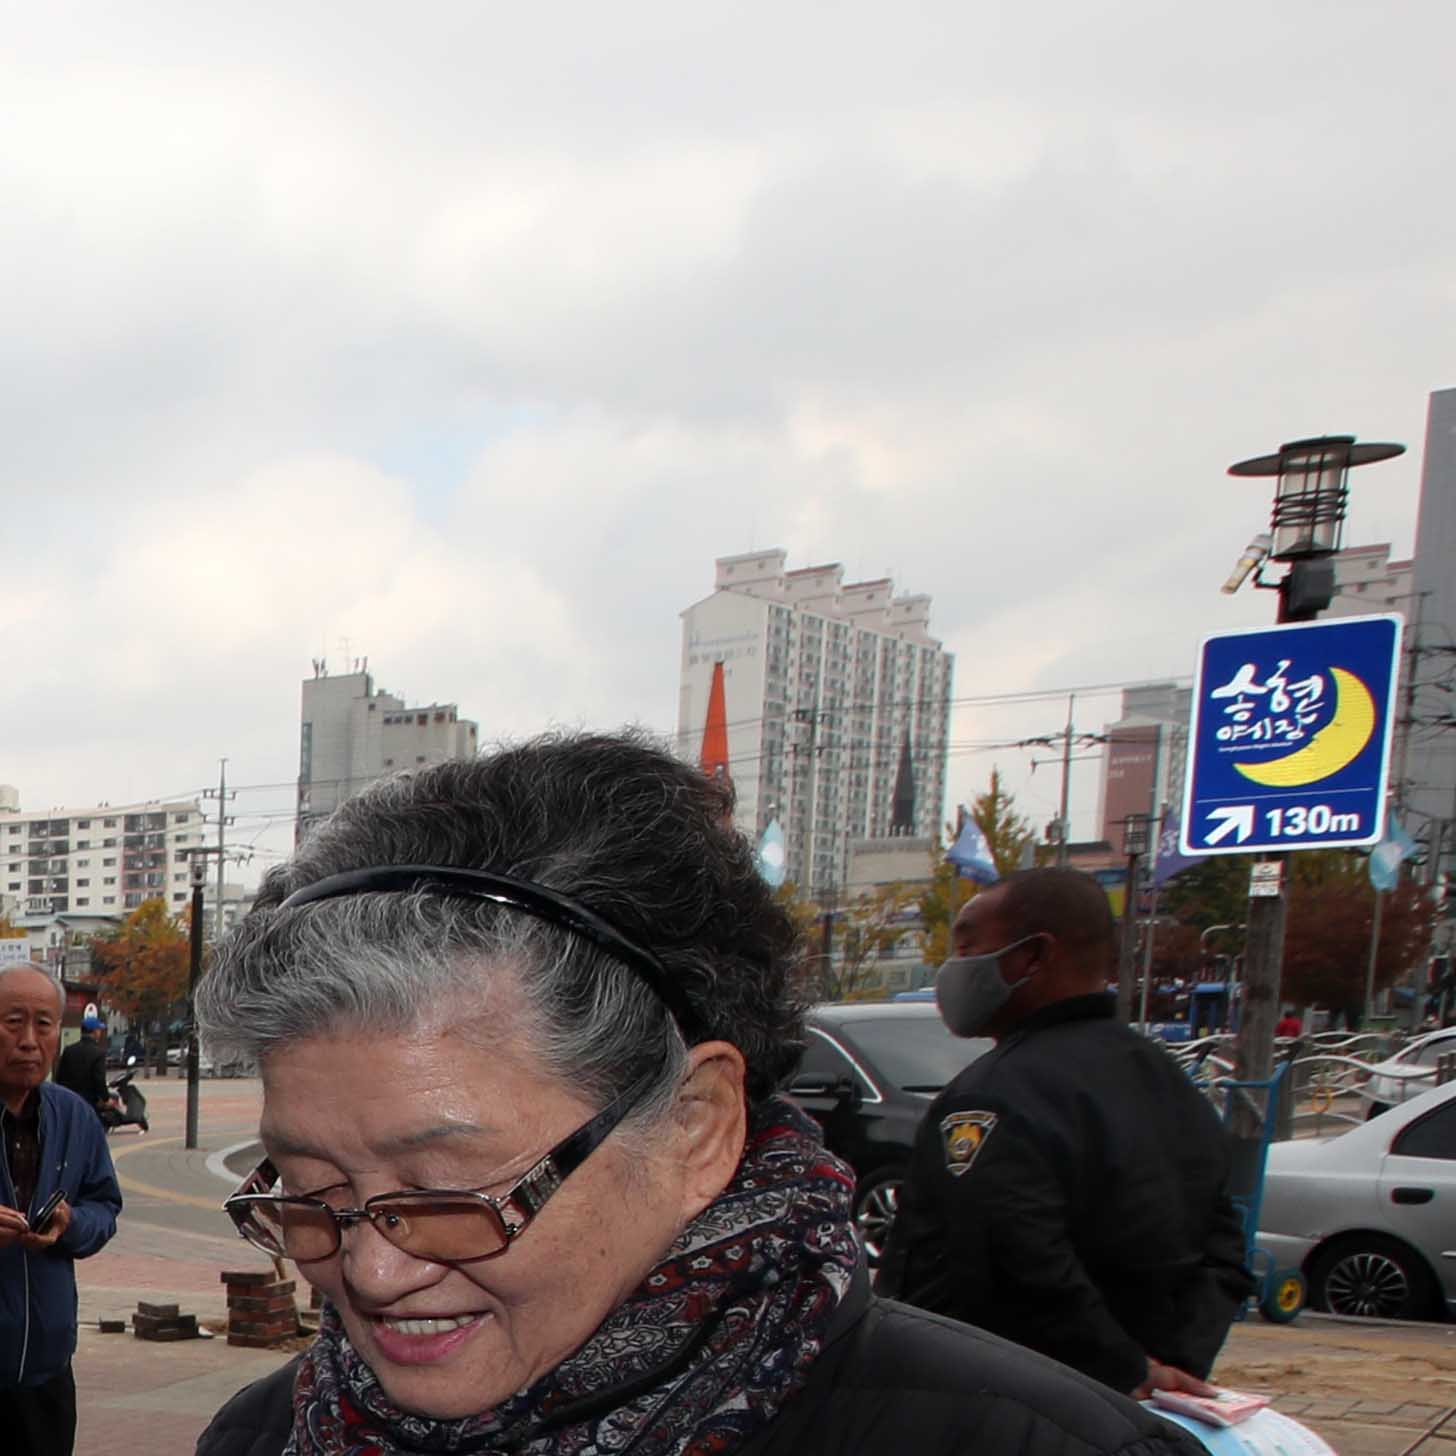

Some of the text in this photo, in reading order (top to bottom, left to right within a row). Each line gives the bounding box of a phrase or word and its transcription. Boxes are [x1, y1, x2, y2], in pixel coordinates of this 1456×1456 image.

[1210, 659, 1325, 721] 송현
[1216, 713, 1318, 741] 야시장
[1266, 803, 1360, 838] 130m
